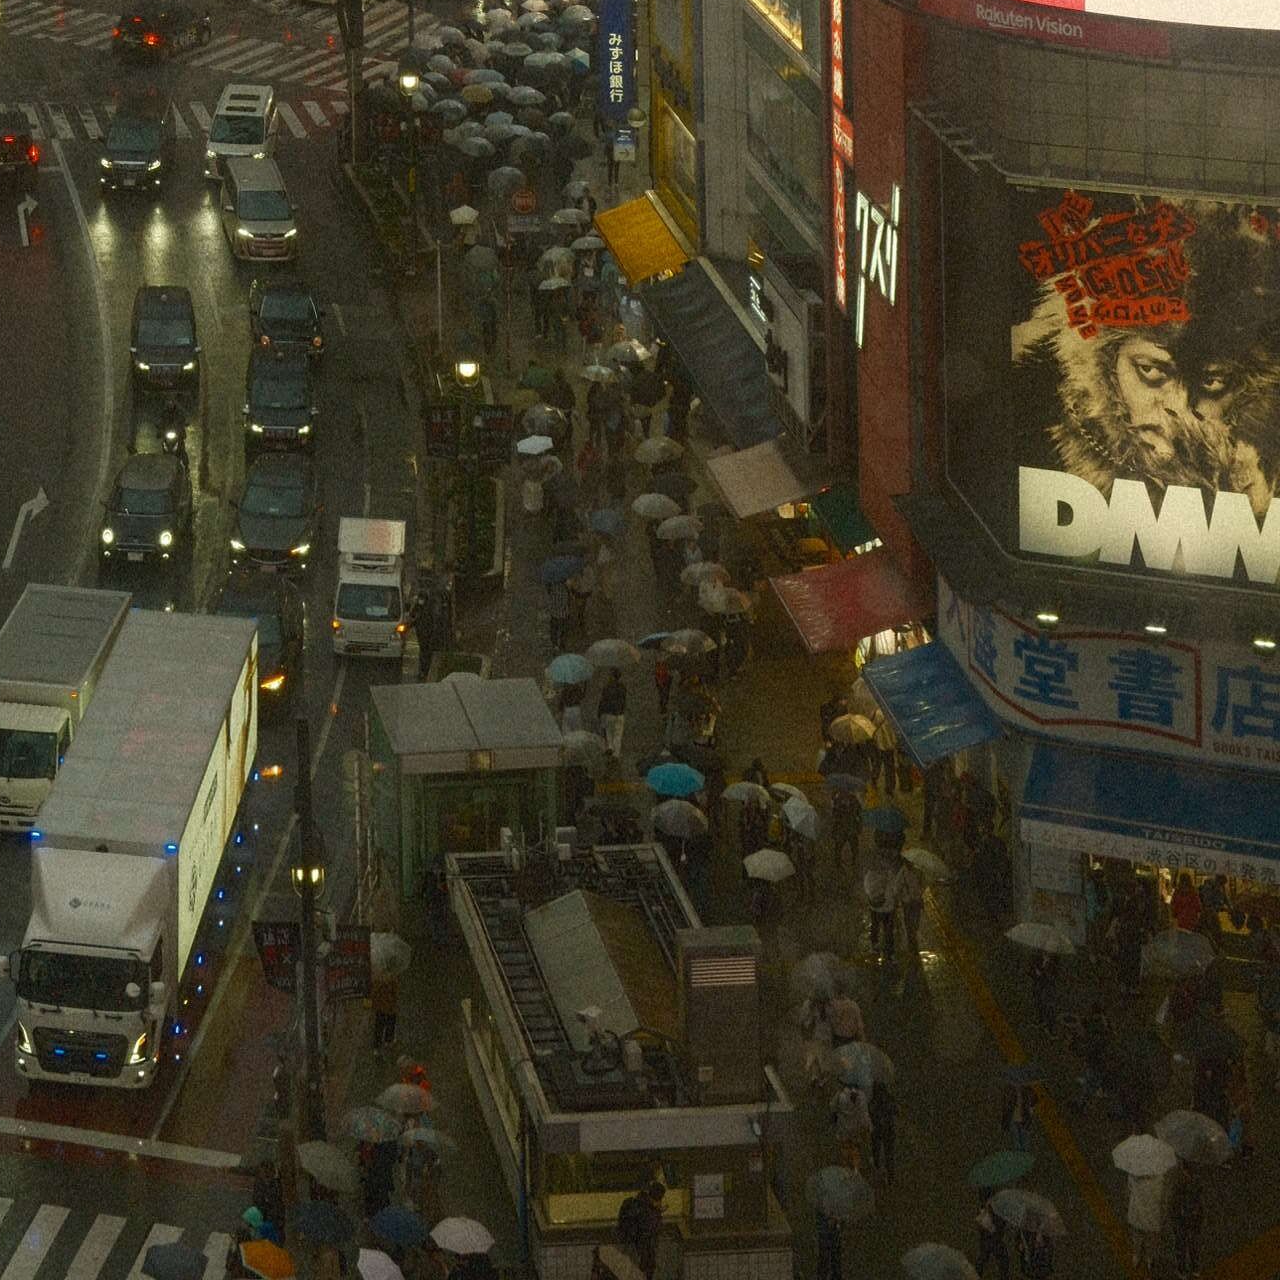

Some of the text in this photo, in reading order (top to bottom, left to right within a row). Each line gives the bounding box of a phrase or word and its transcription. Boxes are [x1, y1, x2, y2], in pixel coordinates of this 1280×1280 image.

[975, 3, 1083, 38] Rakuten Vision
[608, 32, 623, 104] みずほ銀行
